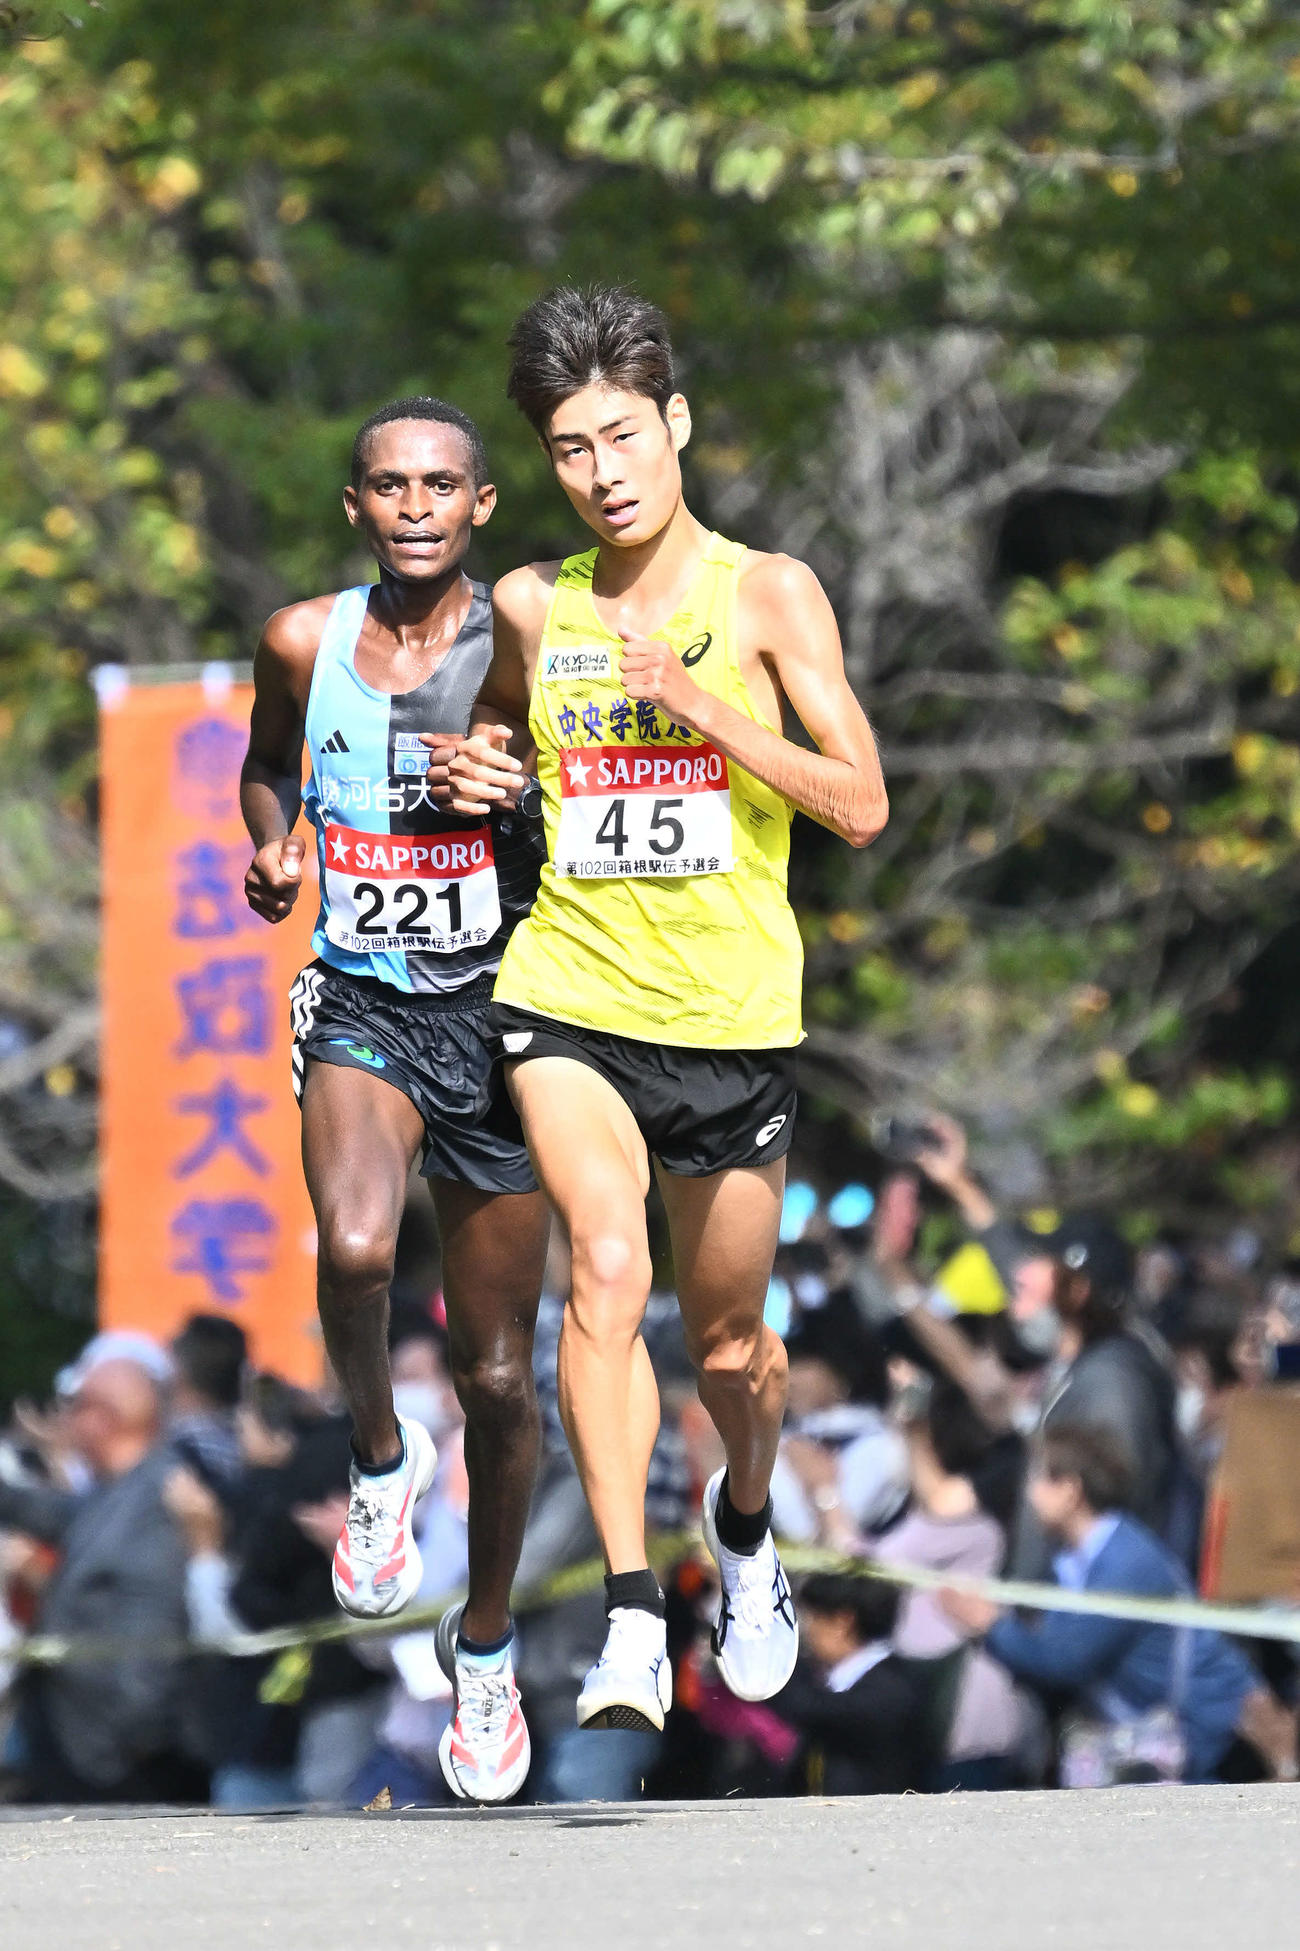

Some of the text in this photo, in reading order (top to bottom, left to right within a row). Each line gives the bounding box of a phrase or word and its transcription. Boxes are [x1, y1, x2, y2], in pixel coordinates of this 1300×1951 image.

[561, 654, 609, 666] KYOWA
[596, 753, 723, 786] SAPPORO
[354, 838, 486, 871] SAPPORO
[566, 856, 721, 876] 第102回箱根駅伝予選会
[352, 881, 463, 936] 221
[339, 927, 488, 951] 第102回箱根駅伝予選会
